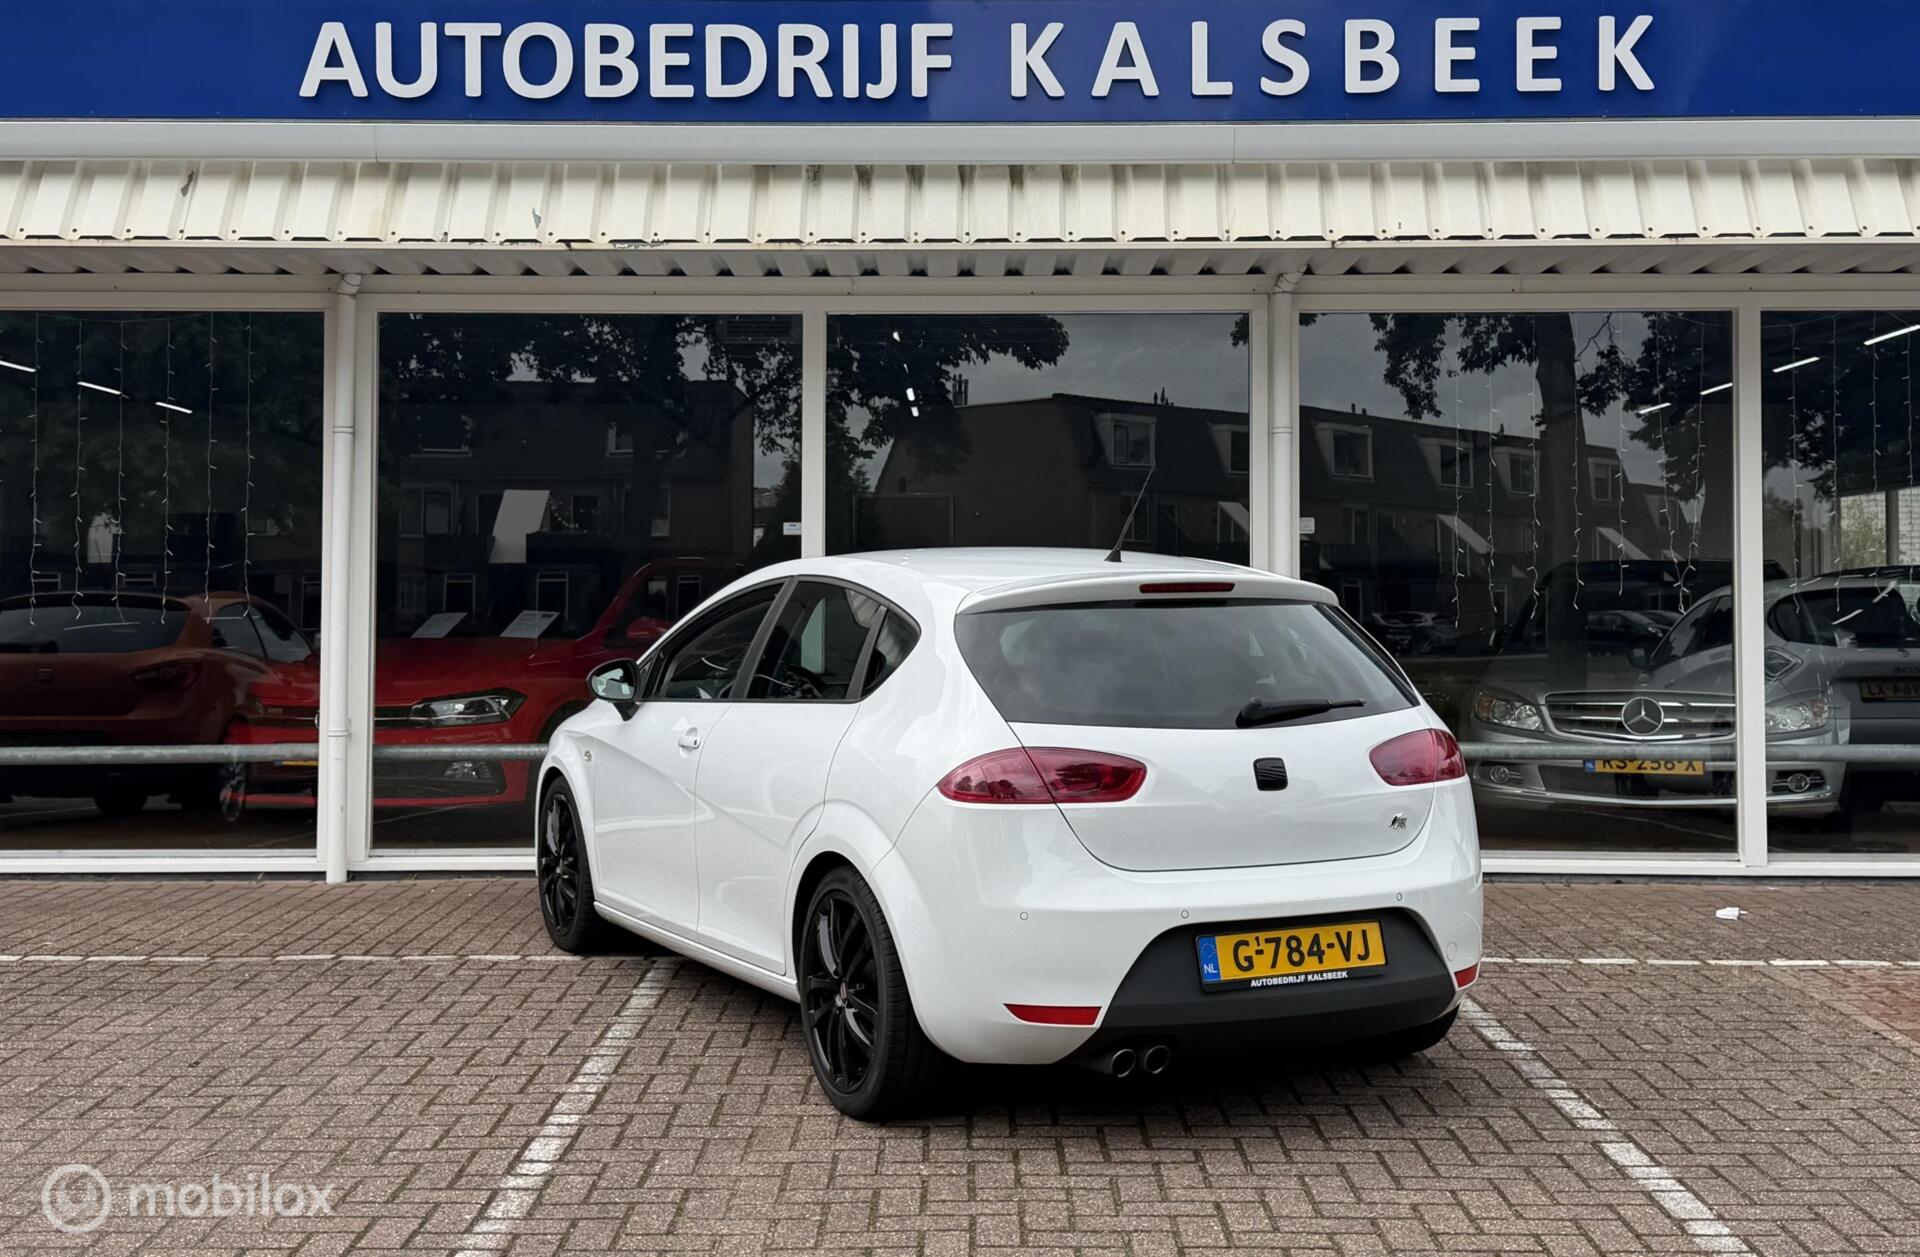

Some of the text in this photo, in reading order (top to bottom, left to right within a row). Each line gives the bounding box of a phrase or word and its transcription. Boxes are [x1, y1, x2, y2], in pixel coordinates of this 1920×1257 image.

[299, 14, 1655, 99] AUTOBEDRIJF KALSBEEK
[1203, 963, 1218, 974] NL
[1250, 970, 1348, 988] AUTOBEDRIJF KALSBEEK
